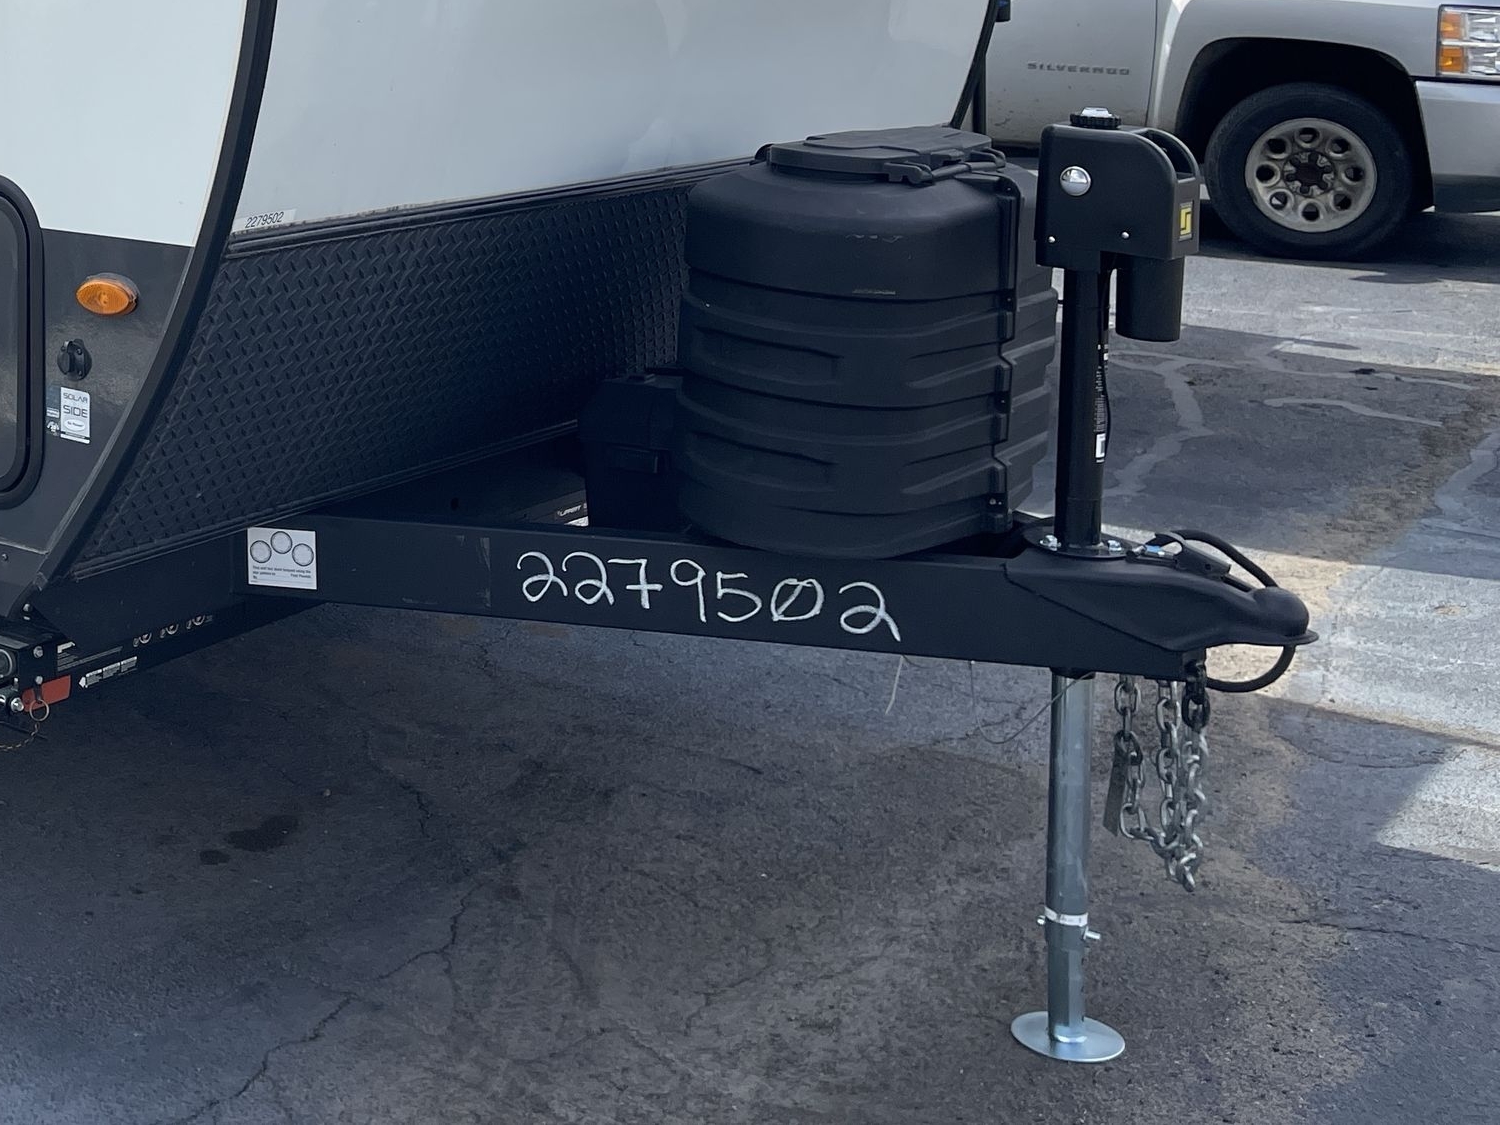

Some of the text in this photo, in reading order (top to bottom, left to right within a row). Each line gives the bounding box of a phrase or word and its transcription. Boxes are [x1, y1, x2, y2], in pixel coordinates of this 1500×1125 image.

[1027, 62, 1130, 76] SILVERADO
[245, 211, 284, 228] 2279502
[63, 392, 88, 403] SOLAR
[63, 404, 88, 418] SIDE
[516, 550, 901, 642] 2279502
